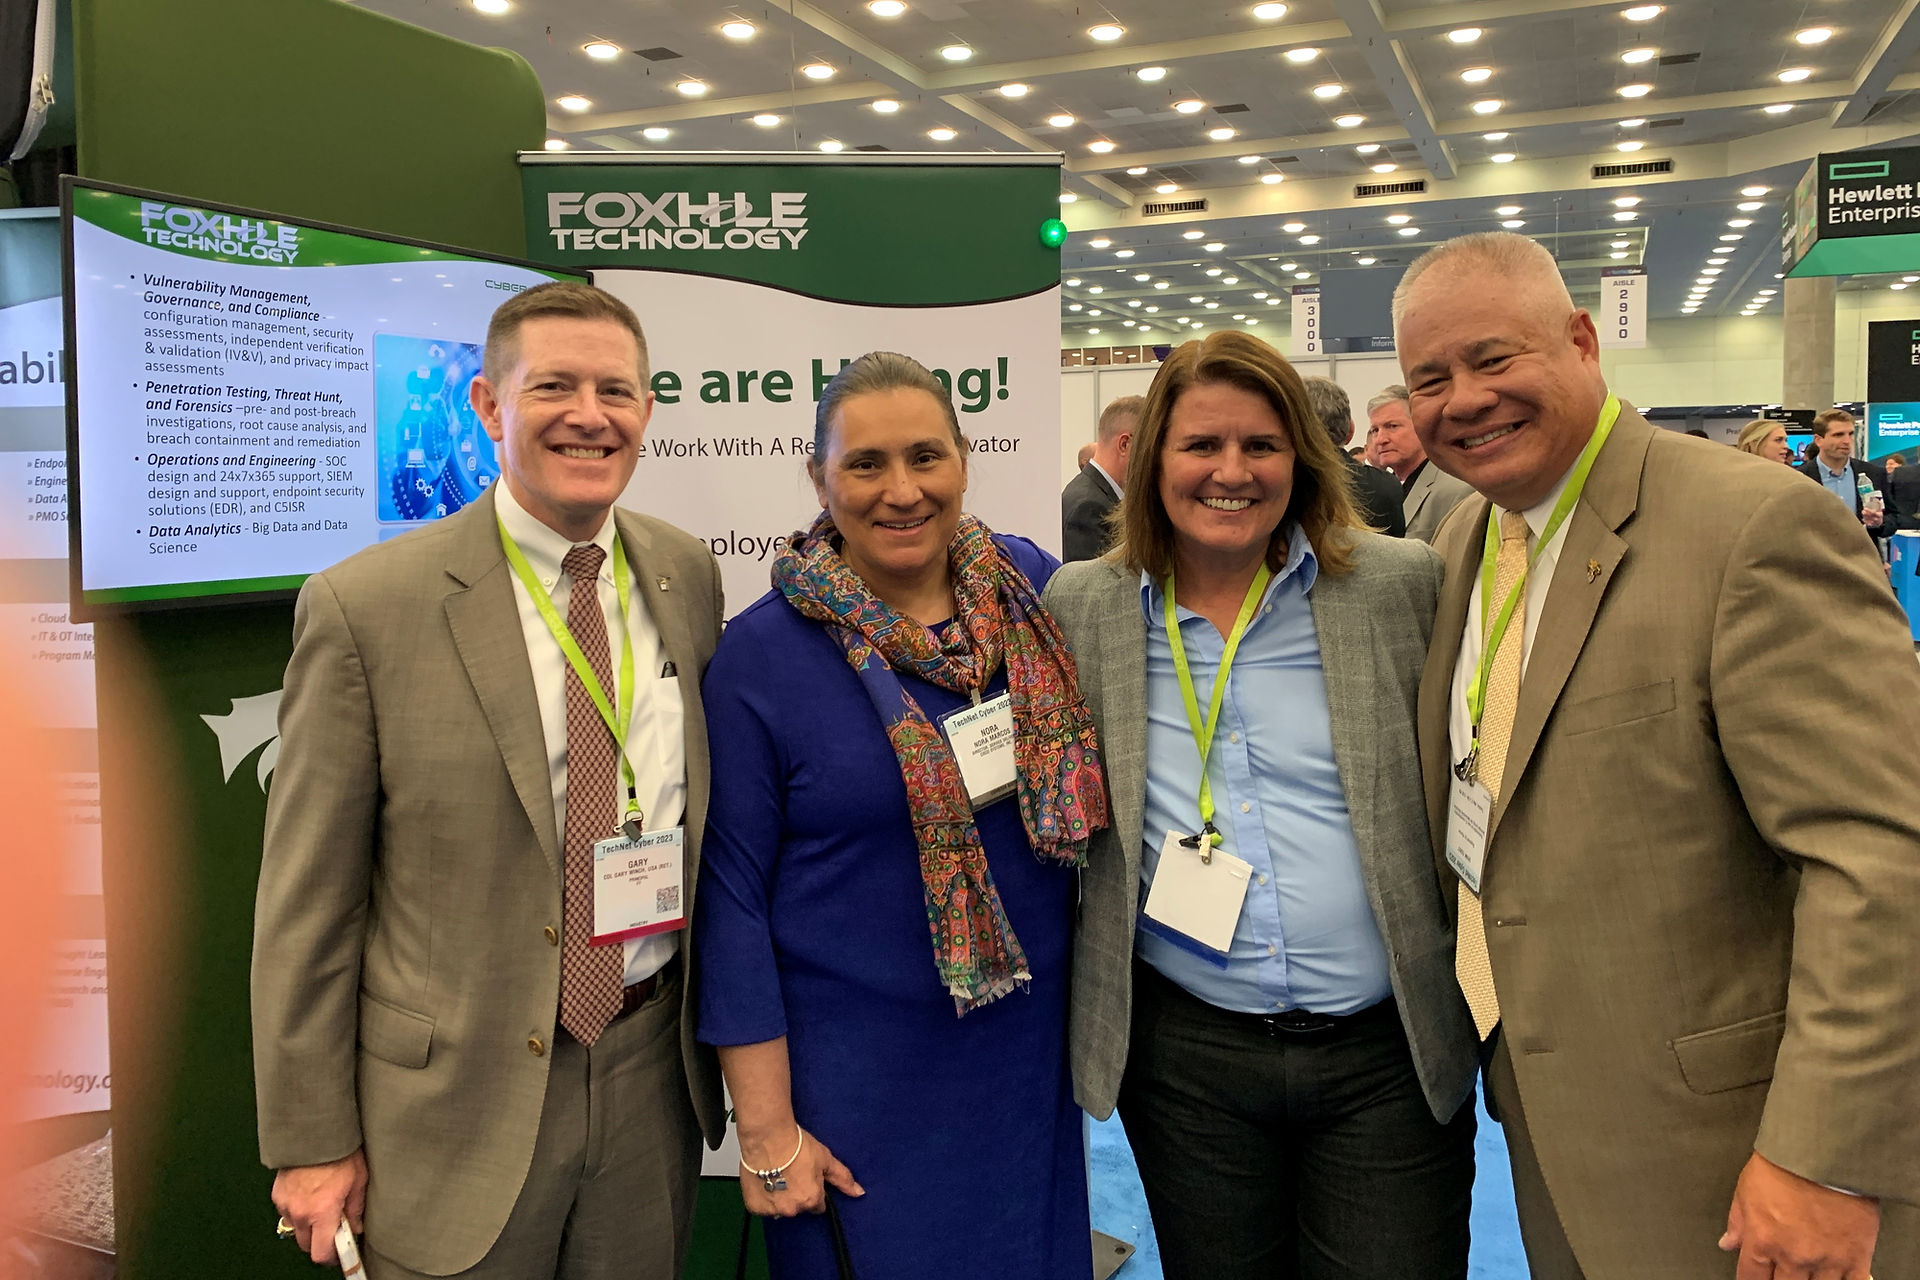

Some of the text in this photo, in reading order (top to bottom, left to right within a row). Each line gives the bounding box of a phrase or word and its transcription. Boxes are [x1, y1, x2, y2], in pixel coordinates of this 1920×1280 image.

[1828, 184, 1913, 204] Hewlett
[1828, 203, 1920, 224] Enterpris
[142, 227, 299, 264] TECHNOLOGY
[549, 229, 809, 250] TECHNOLOGY
[143, 273, 312, 307] Vulnerability Management,
[143, 291, 225, 313] Governance,
[228, 301, 251, 314] and
[254, 303, 320, 322] Compliance
[144, 309, 354, 342] configuration management, security
[144, 326, 364, 356] assessments, independent verification
[145, 341, 369, 372] & validation (IV&V), and privacy impact
[145, 361, 225, 376] assessments
[146, 381, 343, 404] Penetration Testing, Threat Hunt,
[650, 357, 1009, 413] e are Hng!
[146, 399, 171, 411] and
[175, 400, 233, 413] Forensics
[270, 405, 291, 416] and
[294, 406, 356, 418] post-breach
[146, 415, 367, 434] investigations, root cause analysis, and
[147, 432, 361, 449] breach containment and remediation
[652, 438, 708, 457] Work
[713, 437, 763, 456] With
[769, 438, 785, 456] A
[147, 453, 219, 468] Operations
[222, 454, 246, 466] and
[249, 455, 316, 469] Engineering
[325, 455, 347, 467] SOC
[147, 470, 353, 485] design and 24x7x365 support, SIEM
[35, 494, 59, 504] Data
[148, 485, 365, 502] design and support, endpoint security
[36, 511, 59, 521] PMO
[148, 501, 305, 518] solutions (EDR), and C5ISR
[149, 525, 181, 538] Data
[184, 522, 242, 538] Analytics
[252, 521, 270, 536] Big
[273, 520, 298, 533] Data
[301, 520, 321, 532] and
[324, 519, 348, 531] Data
[149, 542, 198, 555] Science
[699, 530, 786, 561] ploye
[38, 613, 67, 623] Cloud
[39, 632, 48, 640] IT
[49, 632, 57, 640] &
[59, 632, 73, 640] OT
[39, 650, 81, 663] Program
[952, 713, 979, 728] TechNet
[978, 706, 996, 719] Cyber
[974, 728, 1011, 748] NORA MARCOS
[980, 724, 999, 737] NORA
[601, 834, 674, 855] TechNet Cyber 2023
[628, 858, 648, 869] GARY
[614, 871, 628, 879] GARY
